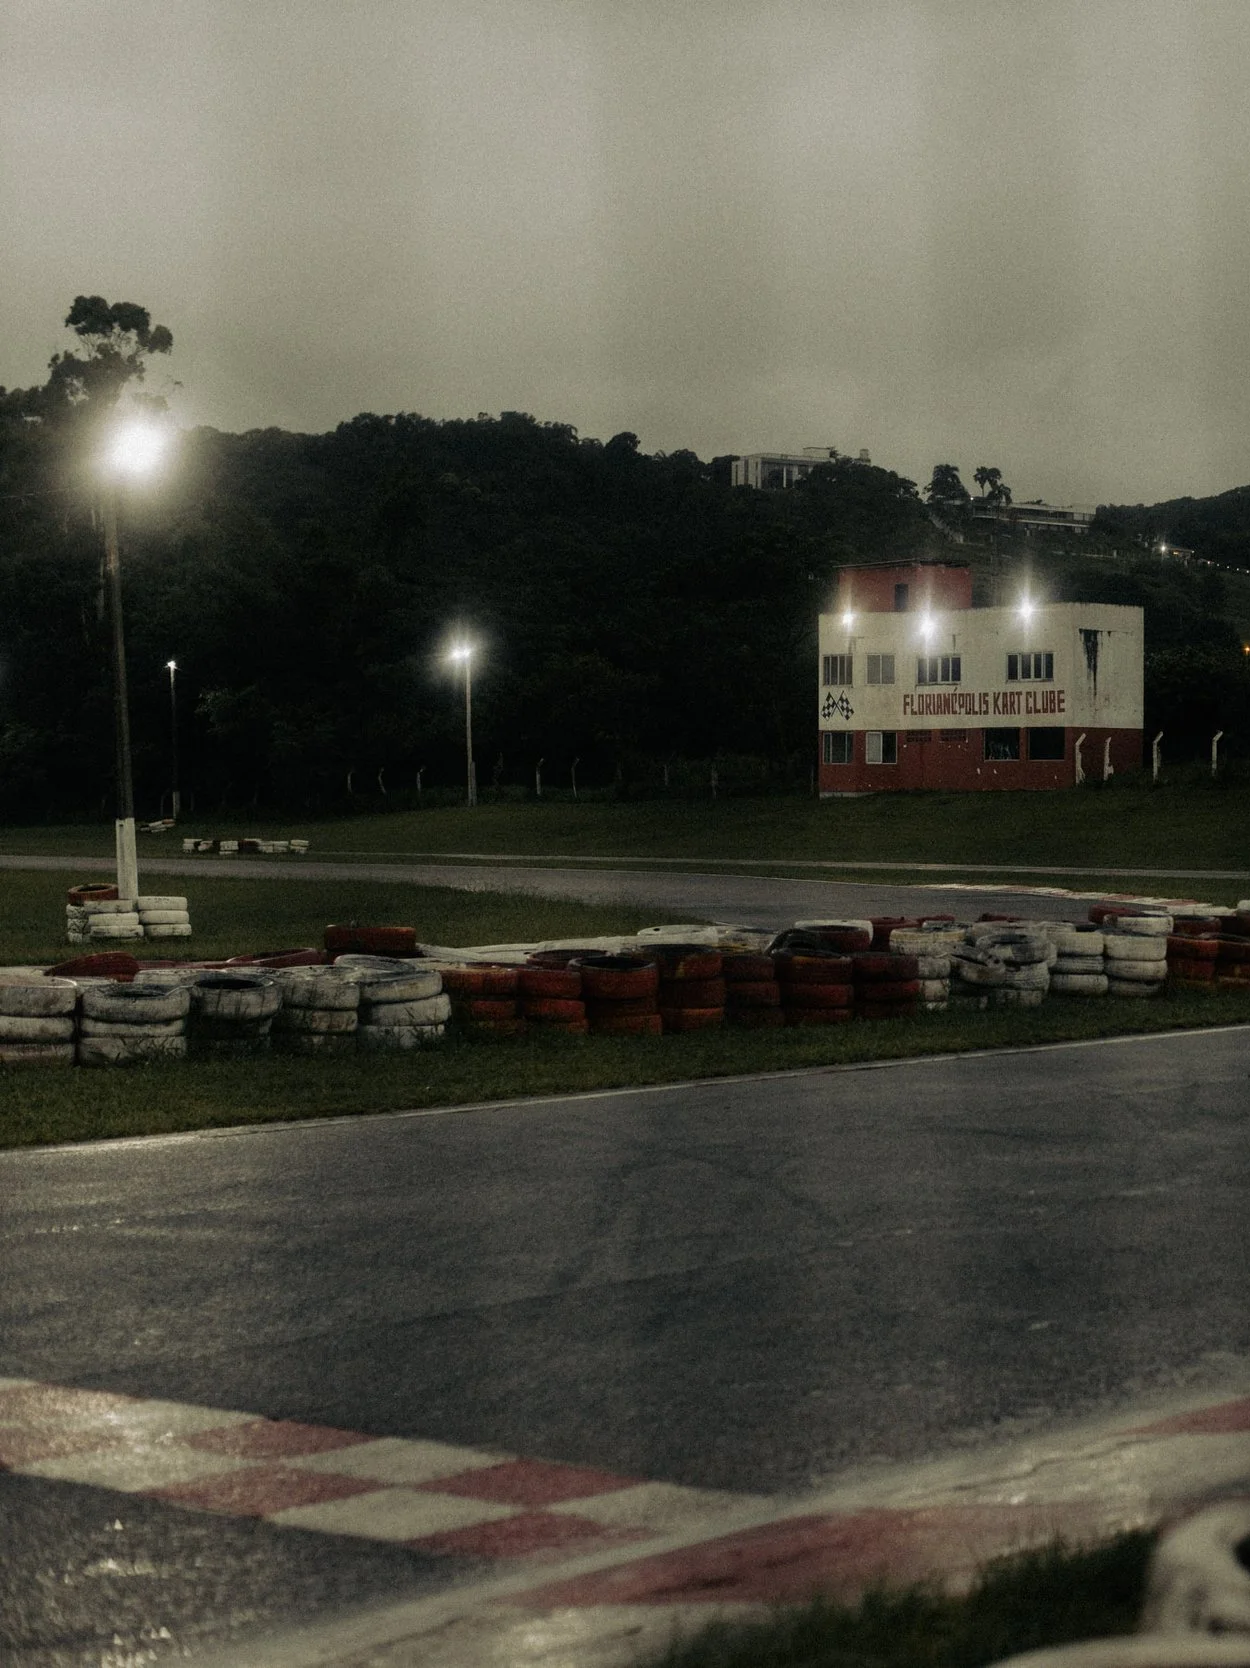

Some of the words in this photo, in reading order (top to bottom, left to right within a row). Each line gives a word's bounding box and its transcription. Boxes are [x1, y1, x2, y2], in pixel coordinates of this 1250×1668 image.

[903, 688, 989, 716] FLORIANÓPOLIS
[993, 691, 1022, 715] KART
[1026, 690, 1065, 714] CLUBE
